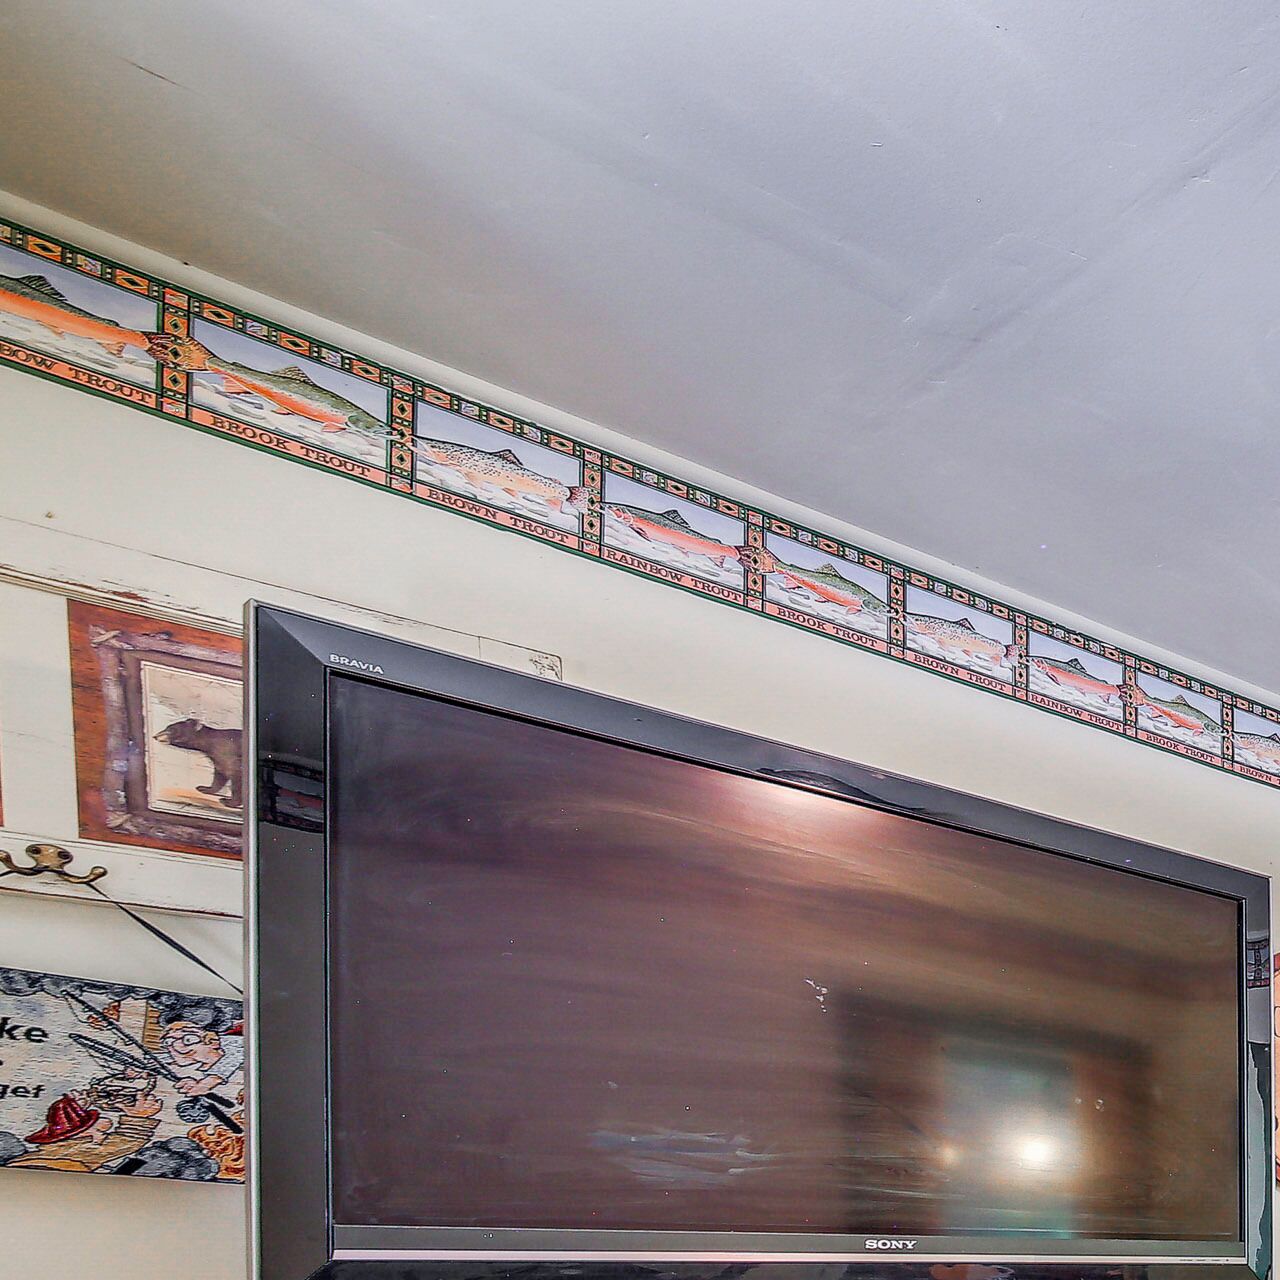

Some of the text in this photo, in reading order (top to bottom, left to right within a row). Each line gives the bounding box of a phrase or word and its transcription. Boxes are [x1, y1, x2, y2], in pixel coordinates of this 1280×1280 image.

[68, 367, 152, 403] TROUT
[209, 414, 372, 478] BROOK TROUT
[427, 488, 570, 544] BROWN TROUT
[606, 549, 742, 602] RAINBOW TROUT
[776, 606, 879, 648] BROOK TROUT
[329, 653, 385, 675] BRAVIA
[913, 653, 1007, 692] BROWN TROUT
[1030, 693, 1122, 730] RAINBOW TROUT
[1145, 733, 1216, 763] BROOK TROUT
[1239, 765, 1272, 783] BROWN
[864, 1239, 918, 1250] SONY
